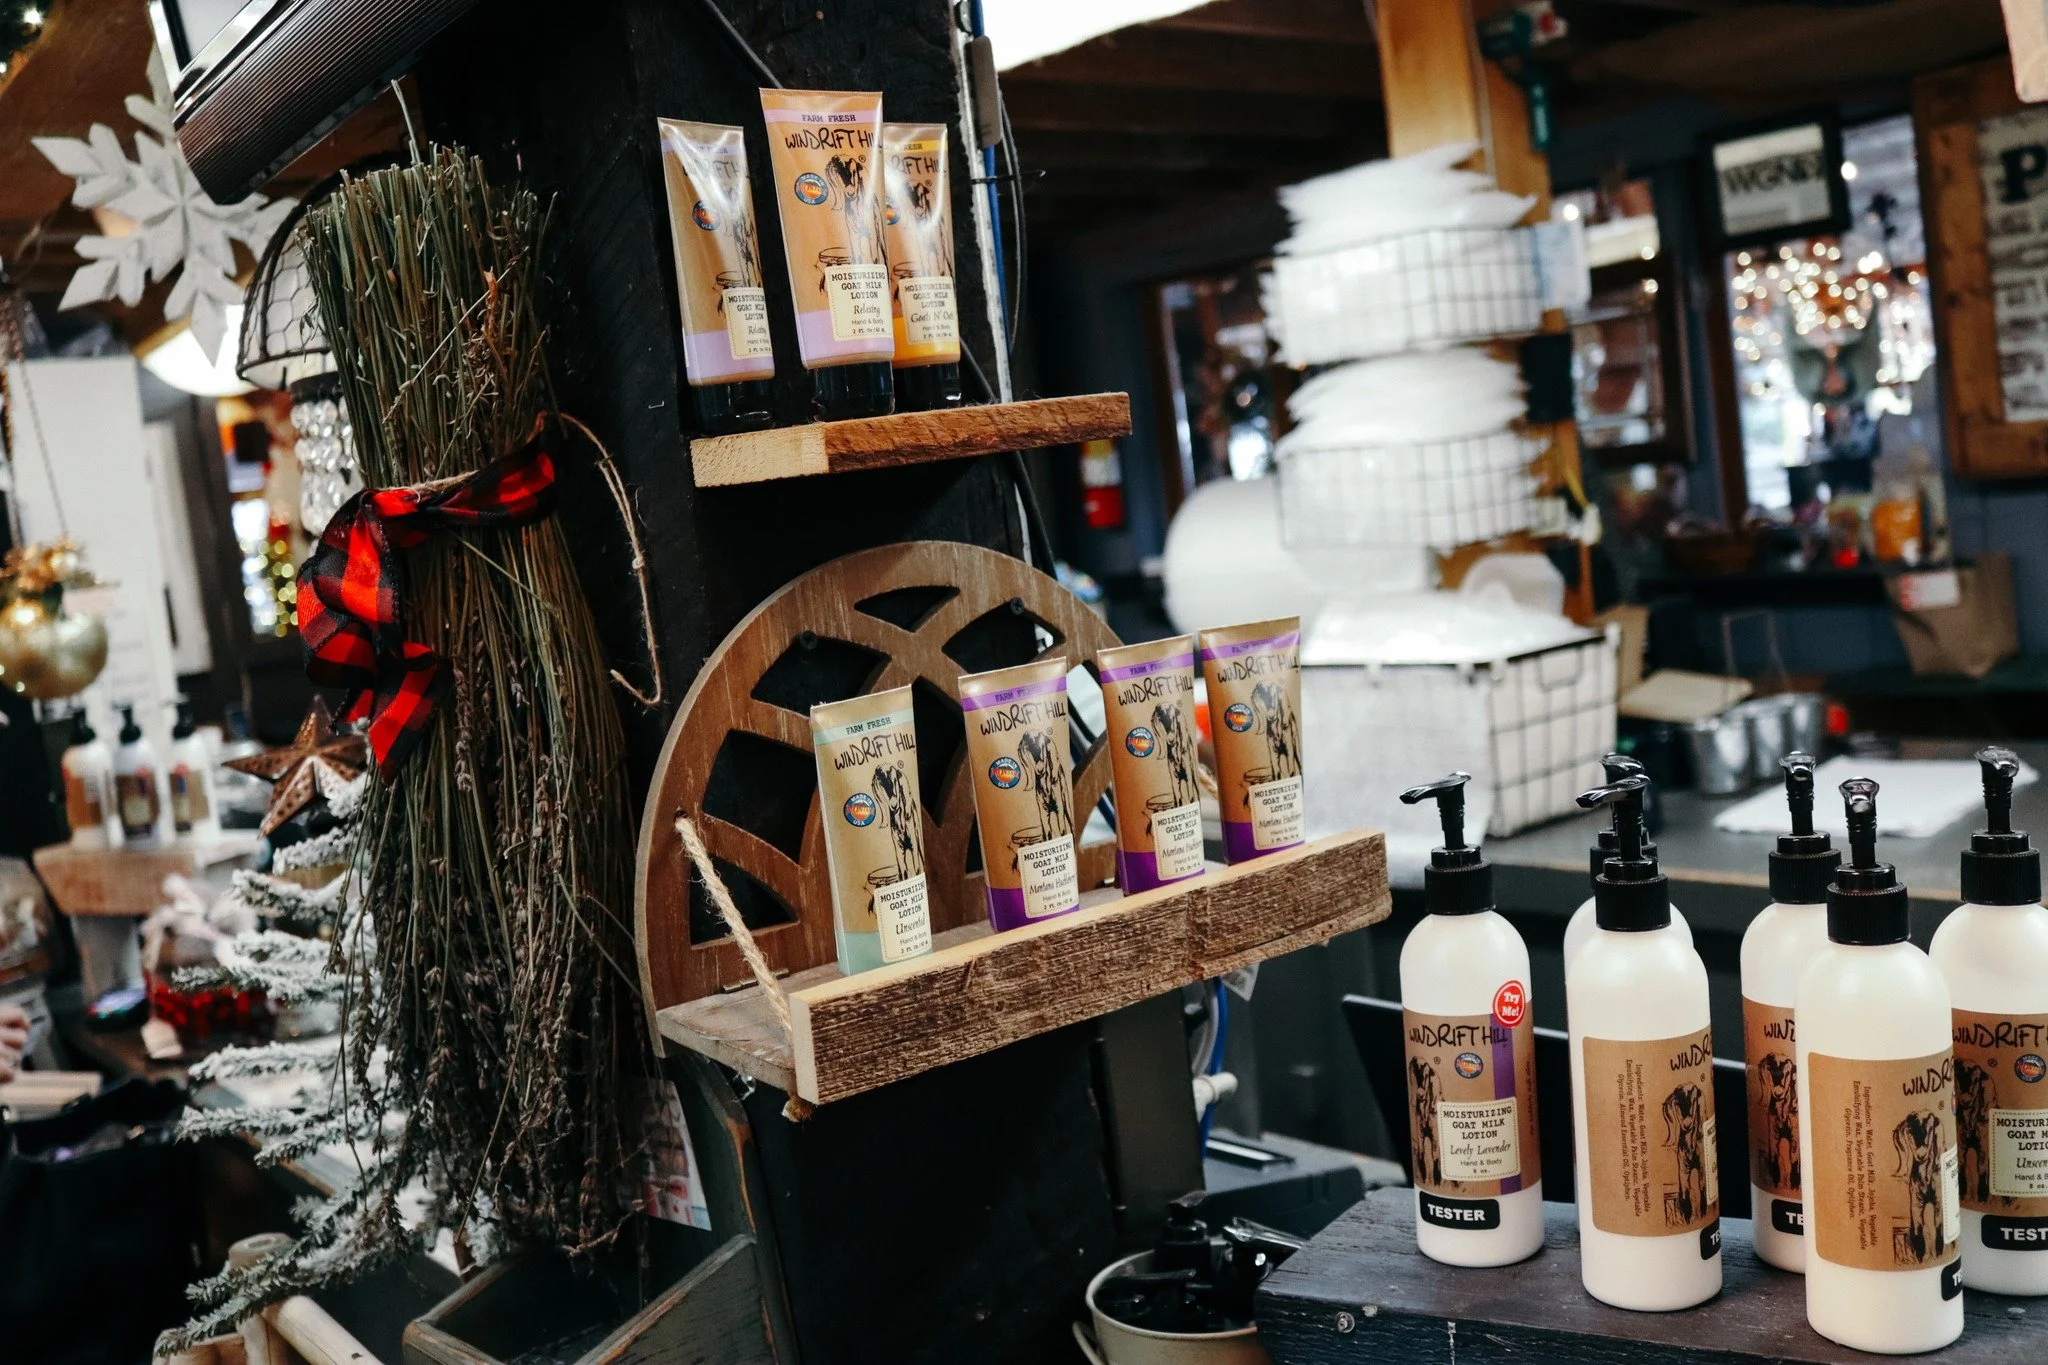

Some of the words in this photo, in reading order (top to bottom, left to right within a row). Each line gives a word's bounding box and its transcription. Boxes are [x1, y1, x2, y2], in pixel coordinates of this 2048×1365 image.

[802, 115, 824, 123] FARM
[828, 114, 857, 123] FRESH
[785, 127, 855, 150] WINDRIFT
[857, 130, 883, 149] HI
[924, 157, 948, 174] HI
[832, 272, 886, 281] MOISTURIZING
[842, 281, 862, 290] GOAT
[865, 281, 883, 289] MILK
[851, 291, 879, 300] LOTION
[854, 302, 881, 318] Relaxing
[921, 301, 945, 309] LOTION
[1130, 665, 1147, 676] FARM
[1218, 656, 1276, 683] WINDRIFT
[995, 691, 1014, 703] FARM
[1118, 676, 1172, 706] WINDRIFT
[1174, 674, 1194, 692] HILL
[846, 724, 864, 735] FARM
[867, 717, 892, 730] FRESH
[980, 702, 1042, 736] WINDRIFT
[1044, 700, 1067, 719] HILL
[834, 733, 893, 771] WINDRIFT
[893, 732, 916, 752] HILL
[851, 794, 866, 802] MADE
[1165, 823, 1182, 834] GOAT
[1173, 829, 1195, 841] LOTION
[1033, 858, 1051, 869] GOAT
[1055, 852, 1069, 864] MILK
[1042, 863, 1067, 877] LOTION
[889, 898, 908, 911] GOAT
[910, 892, 924, 905] MILK
[898, 904, 922, 919] LOTION
[1504, 992, 1520, 1005] Try
[1502, 1005, 1520, 1017] Me!
[1409, 1023, 1480, 1048] WINDRIFT
[1481, 1026, 1508, 1045] HILL
[1952, 1021, 2045, 1049] WINDRIFT
[1853, 1080, 1861, 1120] Emulsifying
[1443, 1106, 1513, 1119] MOISTURIZING
[1452, 1121, 1477, 1129] GOAT
[1482, 1118, 1505, 1129] MILK
[1462, 1130, 1498, 1140] LOTION
[2007, 1130, 2035, 1139] GOAT
[1450, 1143, 1474, 1160] Lovely
[1477, 1140, 1511, 1155] Lavender
[1621, 1129, 1629, 1157] Essential
[1486, 1159, 1503, 1167] Body
[1845, 1139, 1854, 1173] Fragrance
[1855, 1139, 1864, 1172] Vegetable
[1629, 1114, 1637, 1144] Vegetable
[1633, 1187, 1642, 1217] Vegetable
[1862, 1086, 1872, 1127] Ingredients:
[1868, 1214, 1878, 1247] Vegetable
[1857, 1173, 1865, 1189] Palm
[1642, 1182, 1651, 1212] Vegetable
[1427, 1203, 1486, 1221] TESTER
[1858, 1218, 1867, 1251] Vegetable
[2000, 1227, 2048, 1241] TEST
